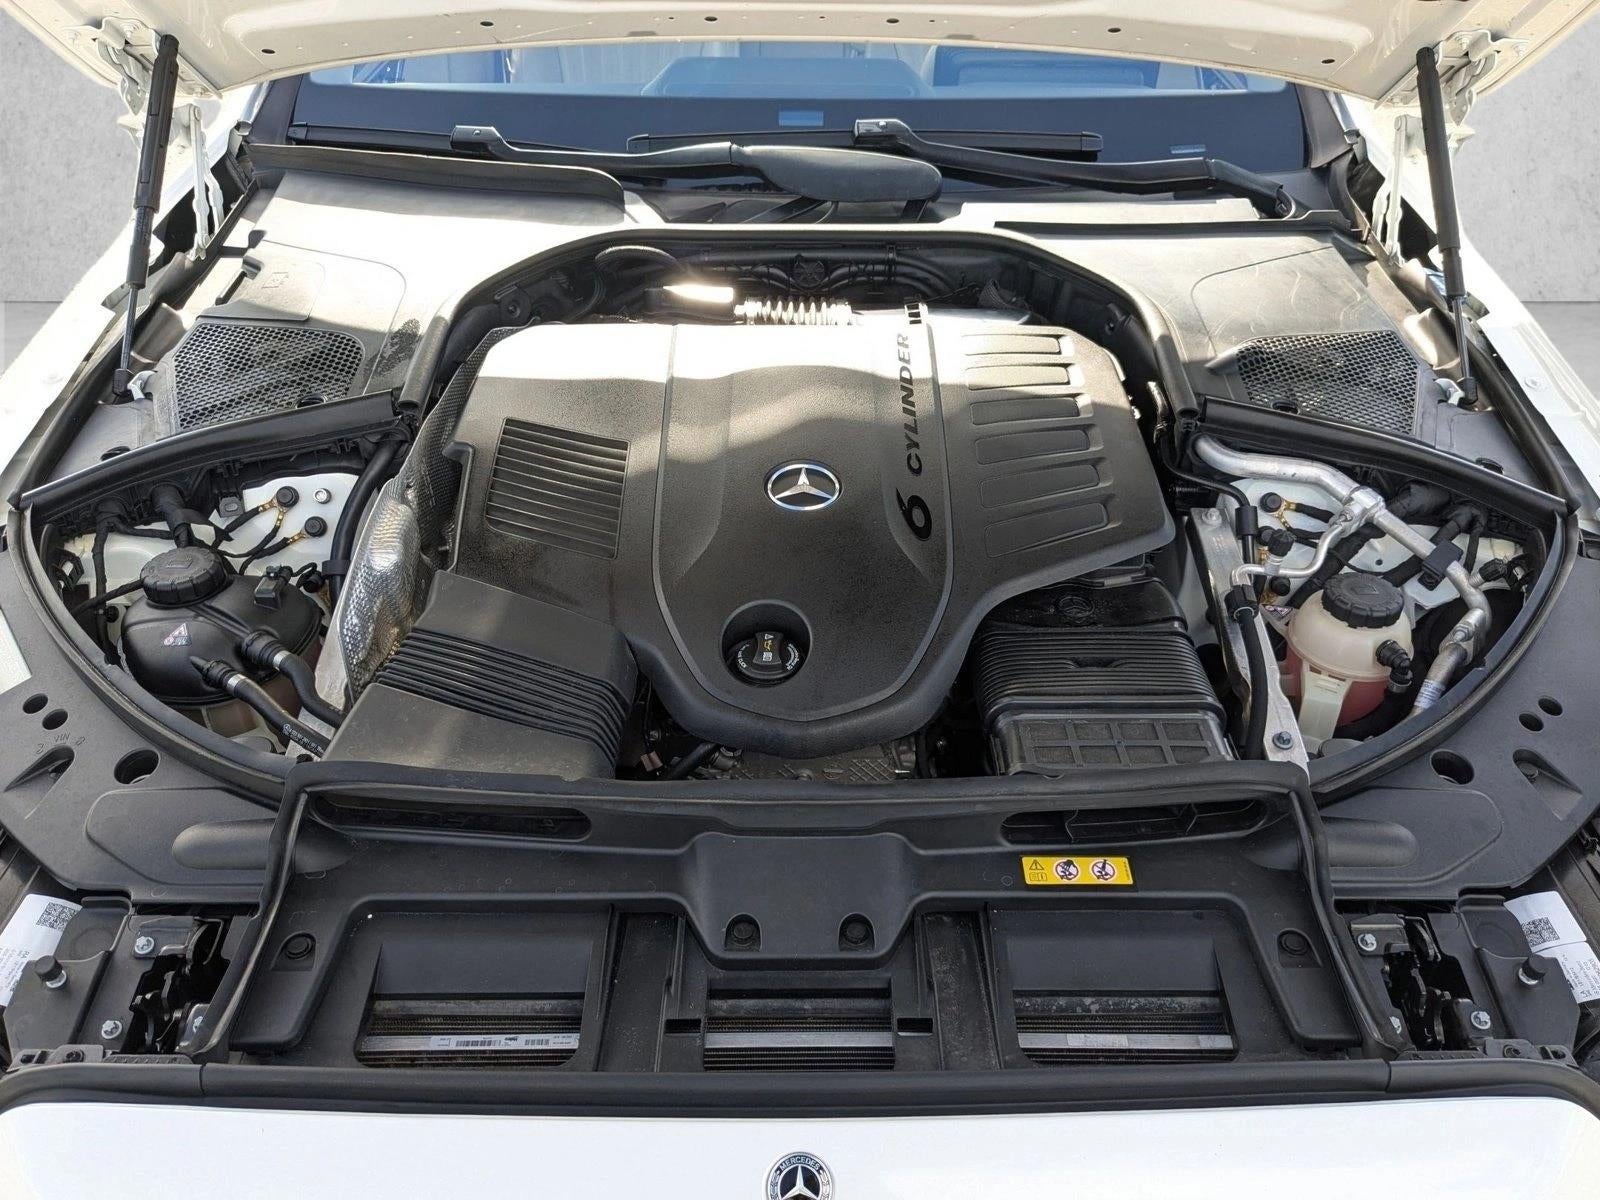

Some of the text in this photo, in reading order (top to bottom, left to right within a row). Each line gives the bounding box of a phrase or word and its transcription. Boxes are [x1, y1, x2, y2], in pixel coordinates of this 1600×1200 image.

[896, 332, 933, 542] 6 CYLINDER
[779, 1156, 820, 1171] MERCEDES
